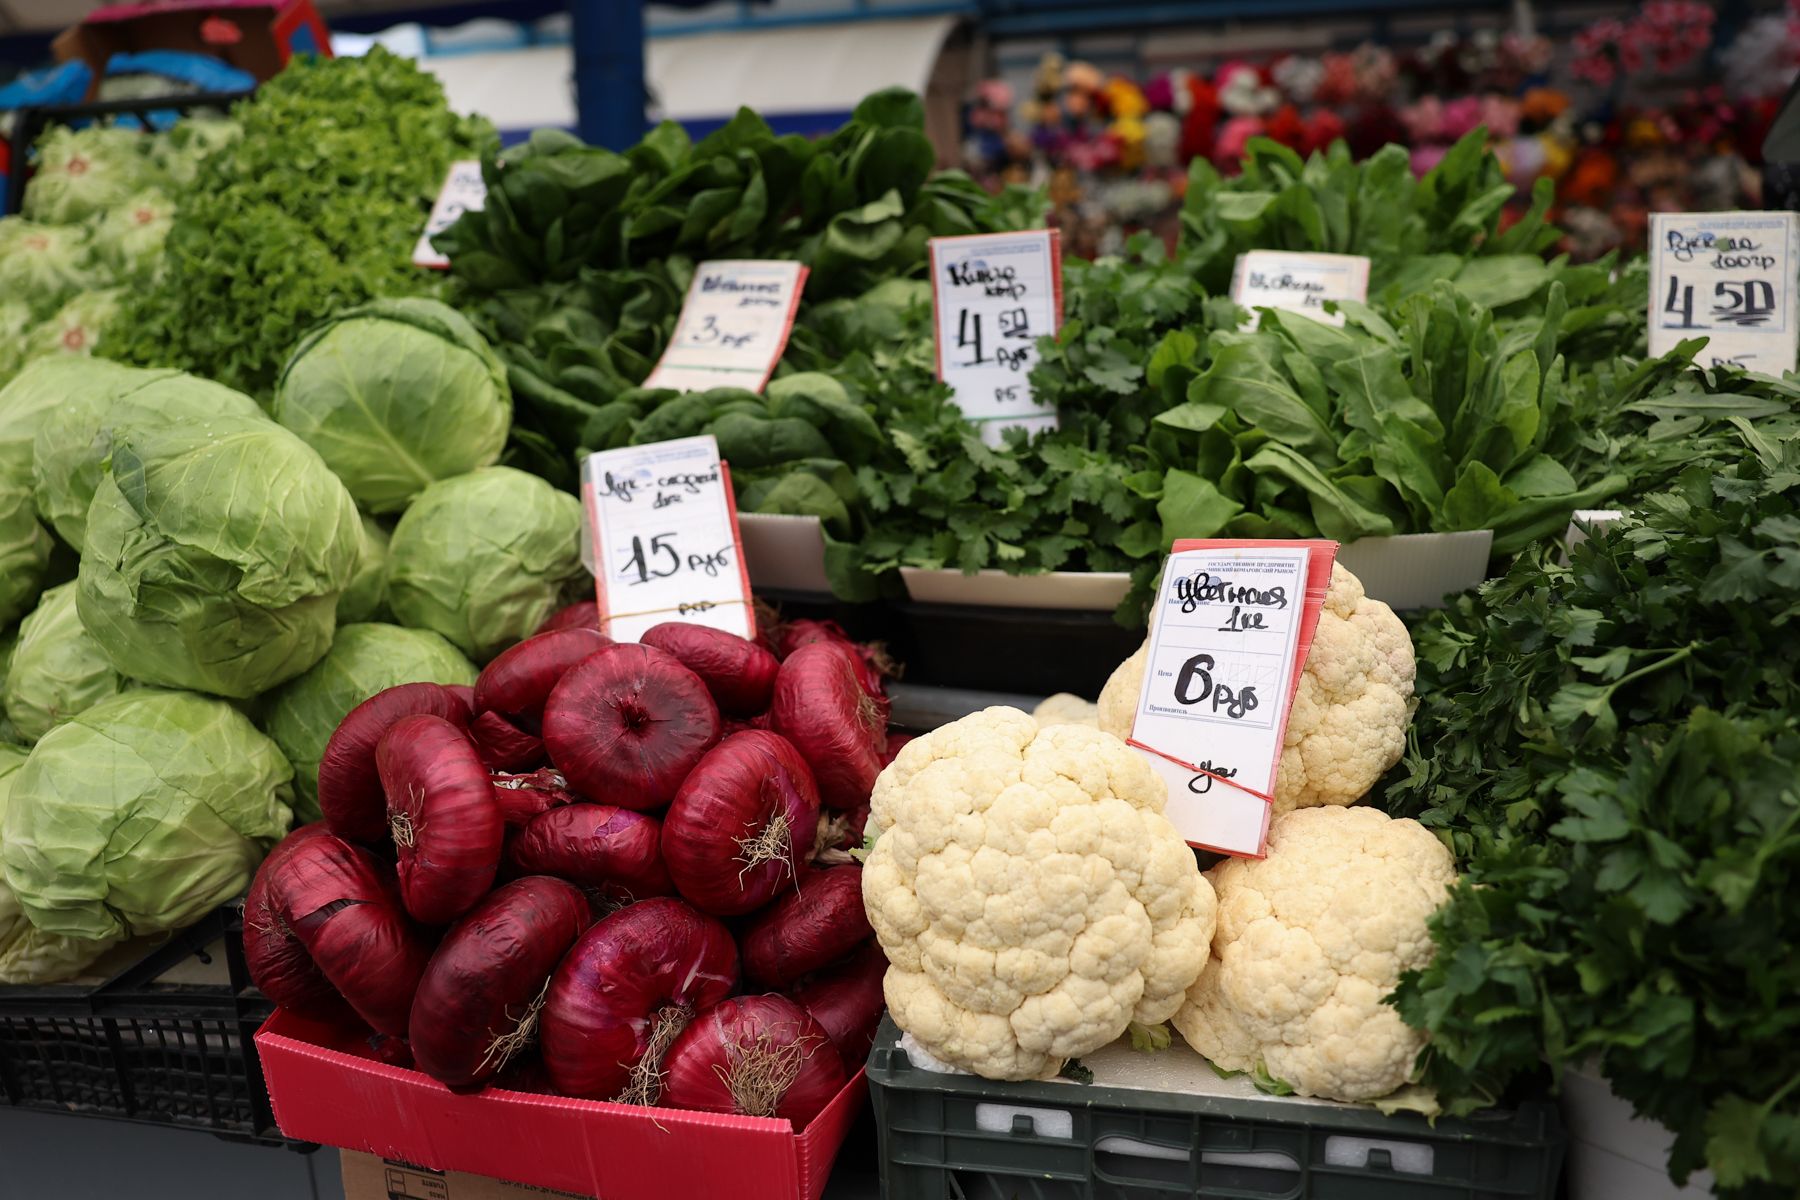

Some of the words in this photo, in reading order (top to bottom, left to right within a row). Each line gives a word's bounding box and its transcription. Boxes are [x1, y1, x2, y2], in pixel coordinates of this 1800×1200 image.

[1668, 229, 1762, 262] Руккла
[1664, 276, 1700, 328] 4
[1713, 280, 1776, 315] 50
[958, 308, 993, 366] 4
[999, 308, 1029, 333] 50
[599, 471, 636, 502] Лук
[620, 532, 680, 586] 15
[1174, 653, 1215, 705] 6
[1149, 704, 1188, 715] Производитель
